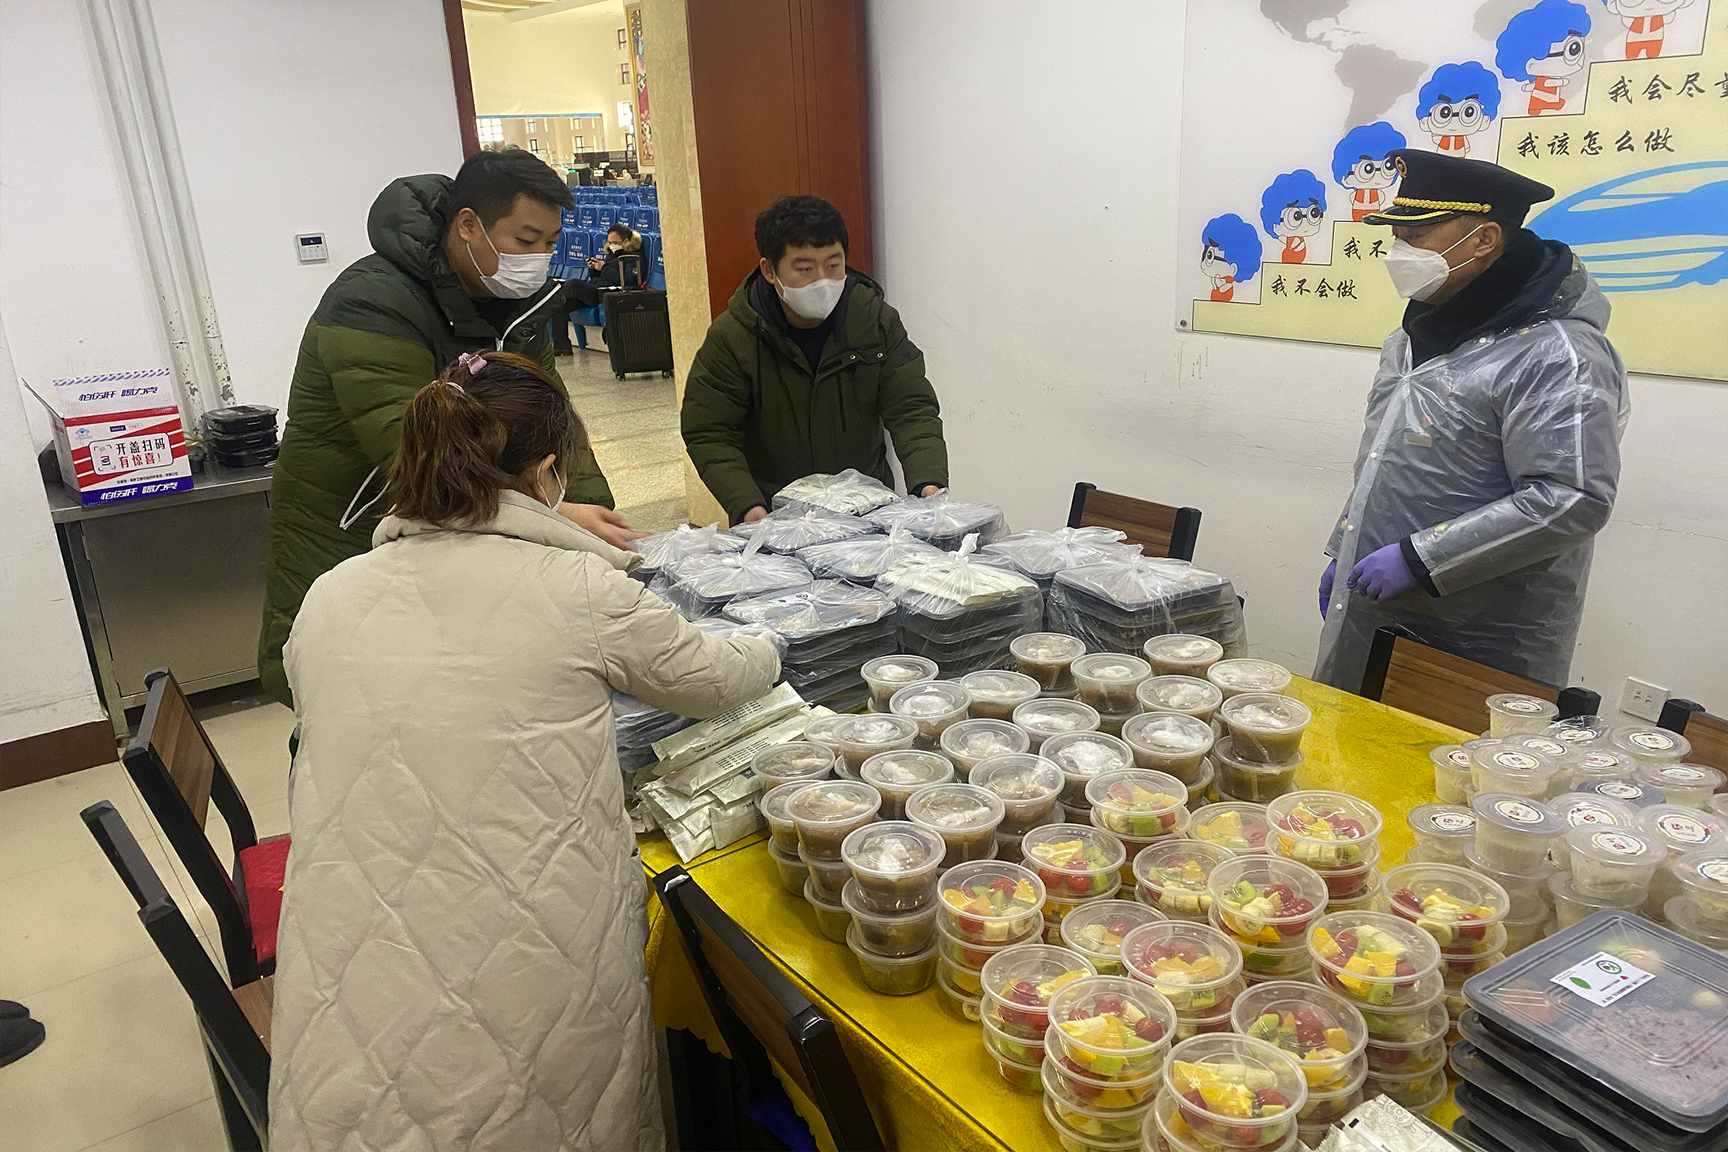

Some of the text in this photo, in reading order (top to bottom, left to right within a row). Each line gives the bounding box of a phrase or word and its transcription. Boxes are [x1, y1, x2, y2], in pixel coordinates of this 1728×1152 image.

[1517, 127, 1675, 159] 我该怎么做
[1271, 275, 1358, 300] 我不会做
[116, 437, 165, 455] 开盖扫码
